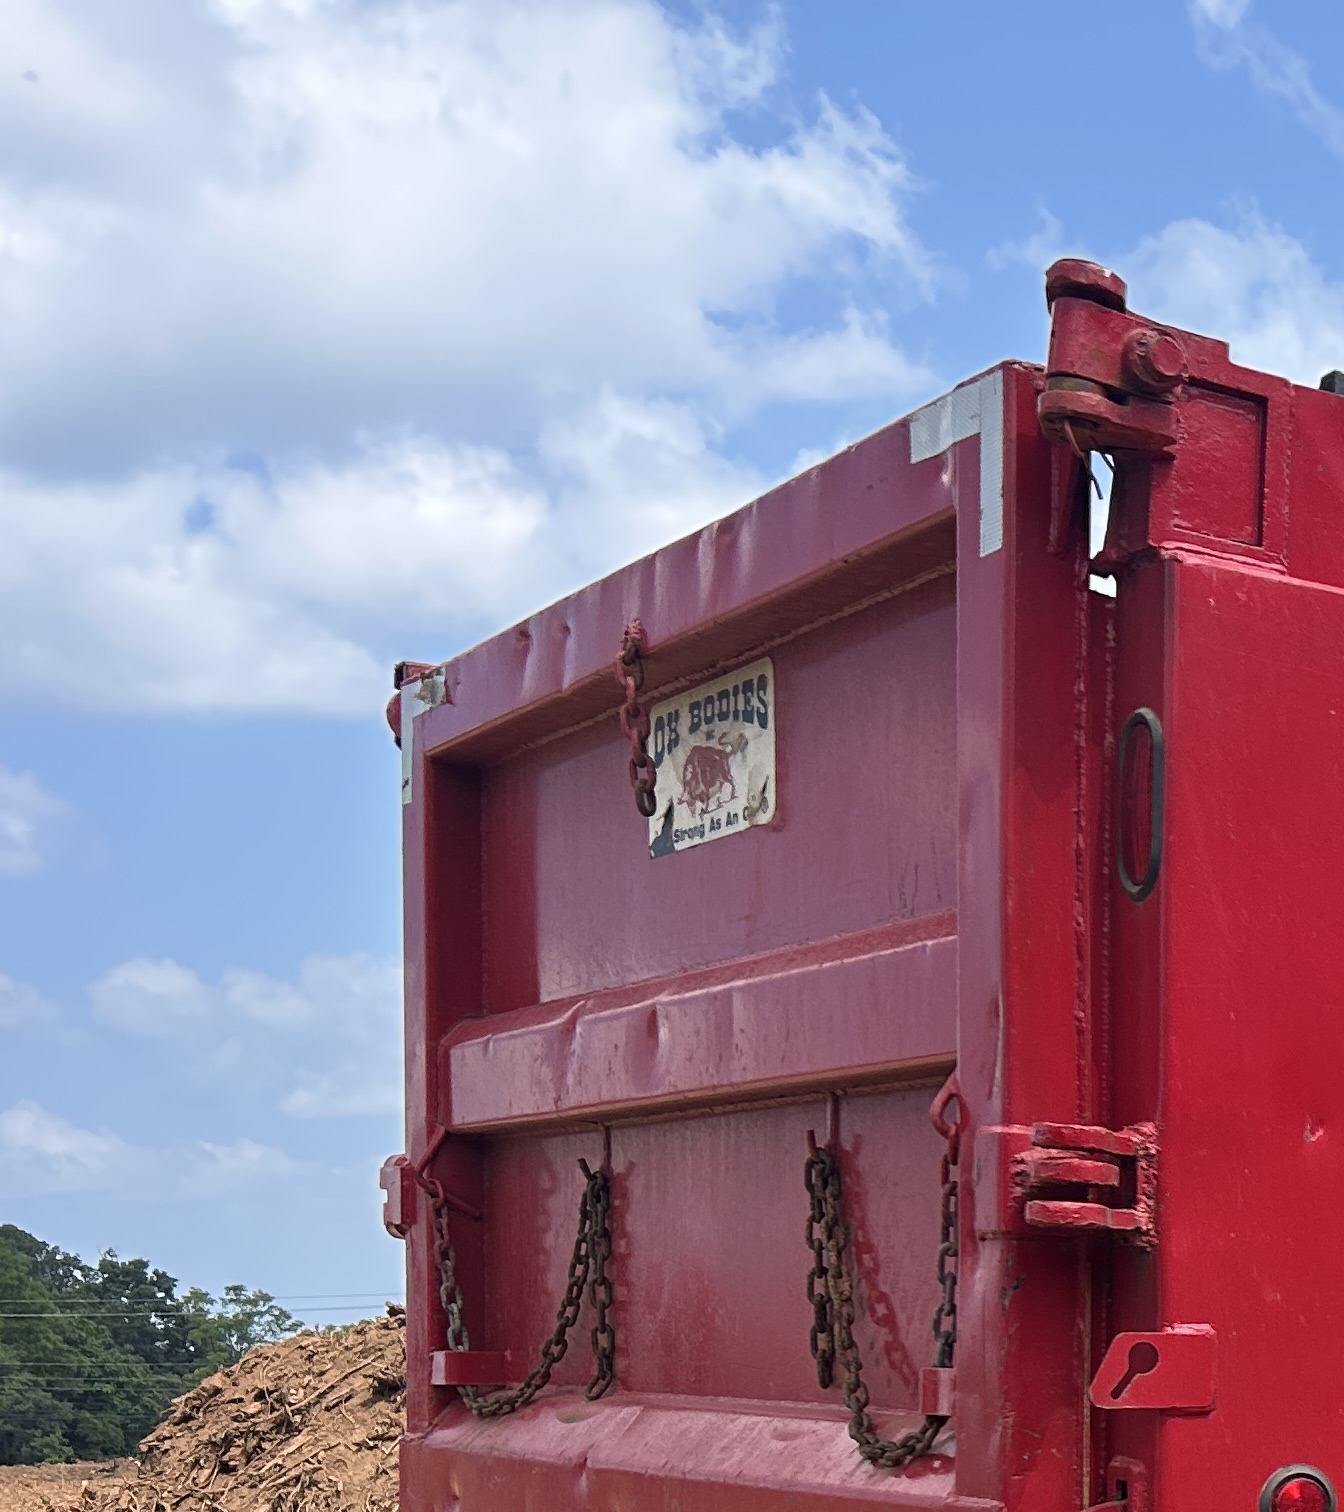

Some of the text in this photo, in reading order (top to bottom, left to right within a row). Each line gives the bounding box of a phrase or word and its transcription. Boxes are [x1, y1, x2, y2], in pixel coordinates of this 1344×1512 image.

[654, 674, 769, 769] OX BODIES
[673, 822, 705, 844] Strong
[709, 816, 721, 832] As
[725, 811, 739, 827] An
